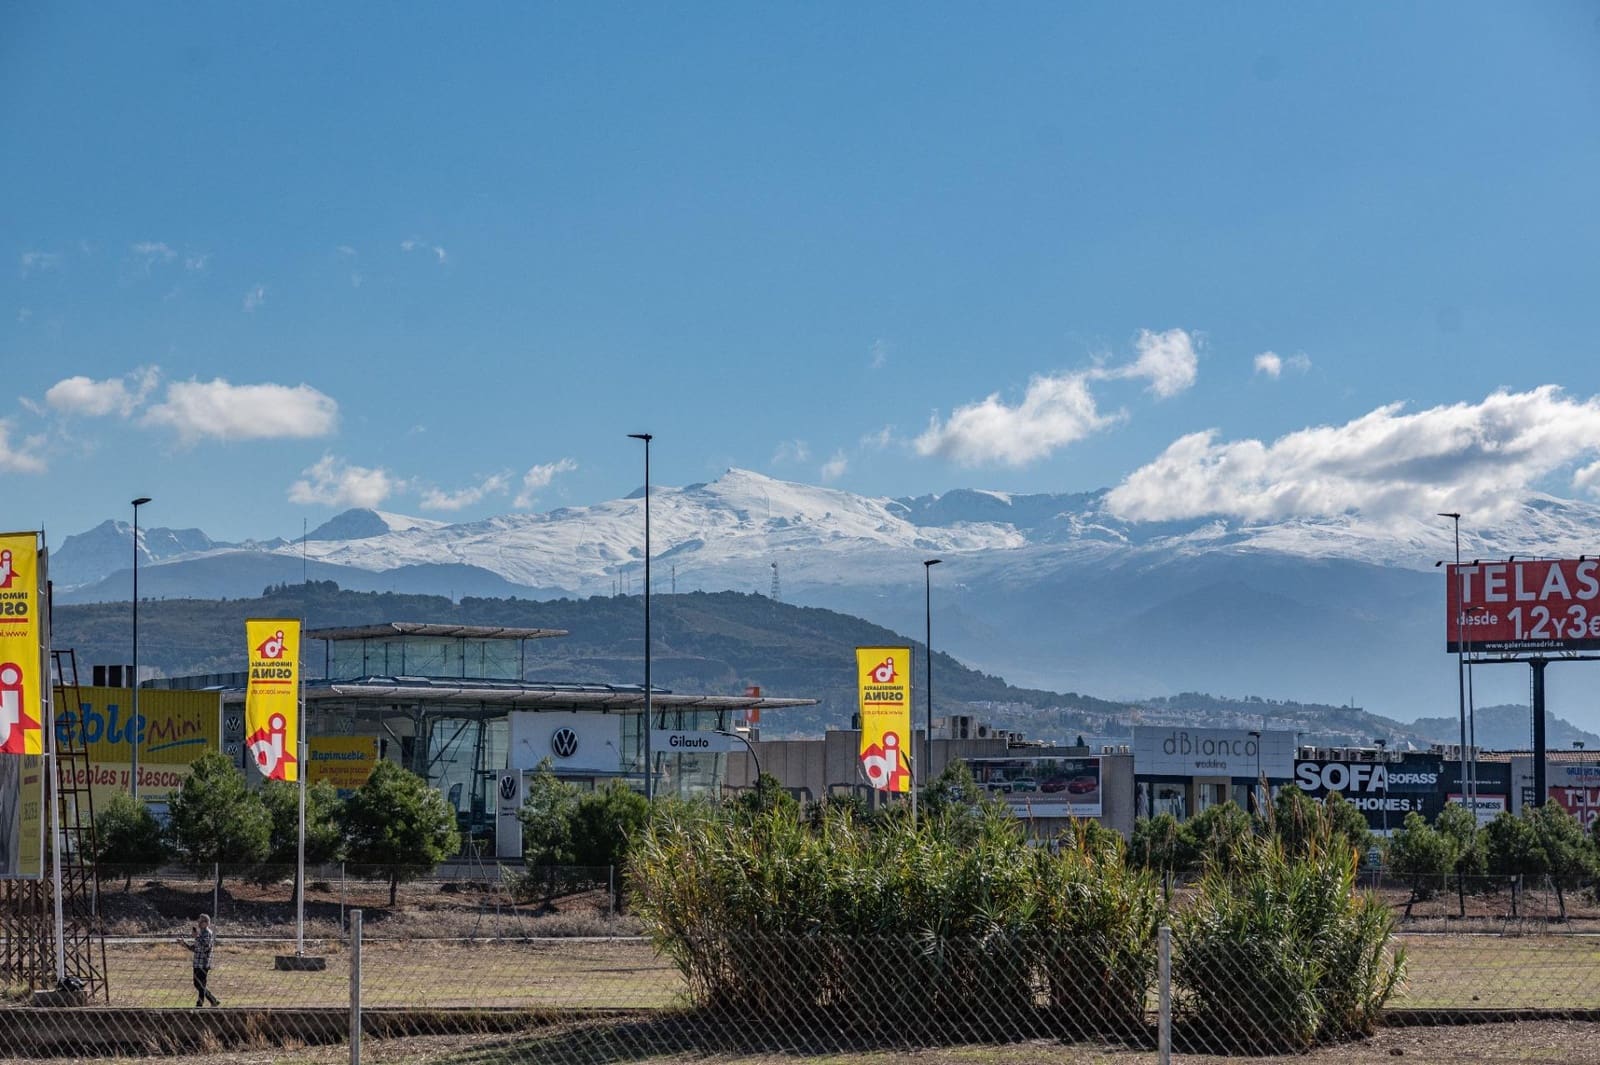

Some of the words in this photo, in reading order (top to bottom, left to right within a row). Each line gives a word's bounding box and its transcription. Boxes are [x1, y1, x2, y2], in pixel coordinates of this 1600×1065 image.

[1454, 561, 1600, 602] TELAS
[1456, 611, 1498, 625] desde
[1485, 641, 1564, 650] www.galeriasmadrid.es
[147, 713, 202, 744] Mini
[669, 735, 709, 747] Gilauto
[1163, 731, 1257, 756] dBlanco
[56, 765, 116, 785] uebles
[1295, 762, 1389, 792] SOFA
[1388, 773, 1437, 784] SOFASS
